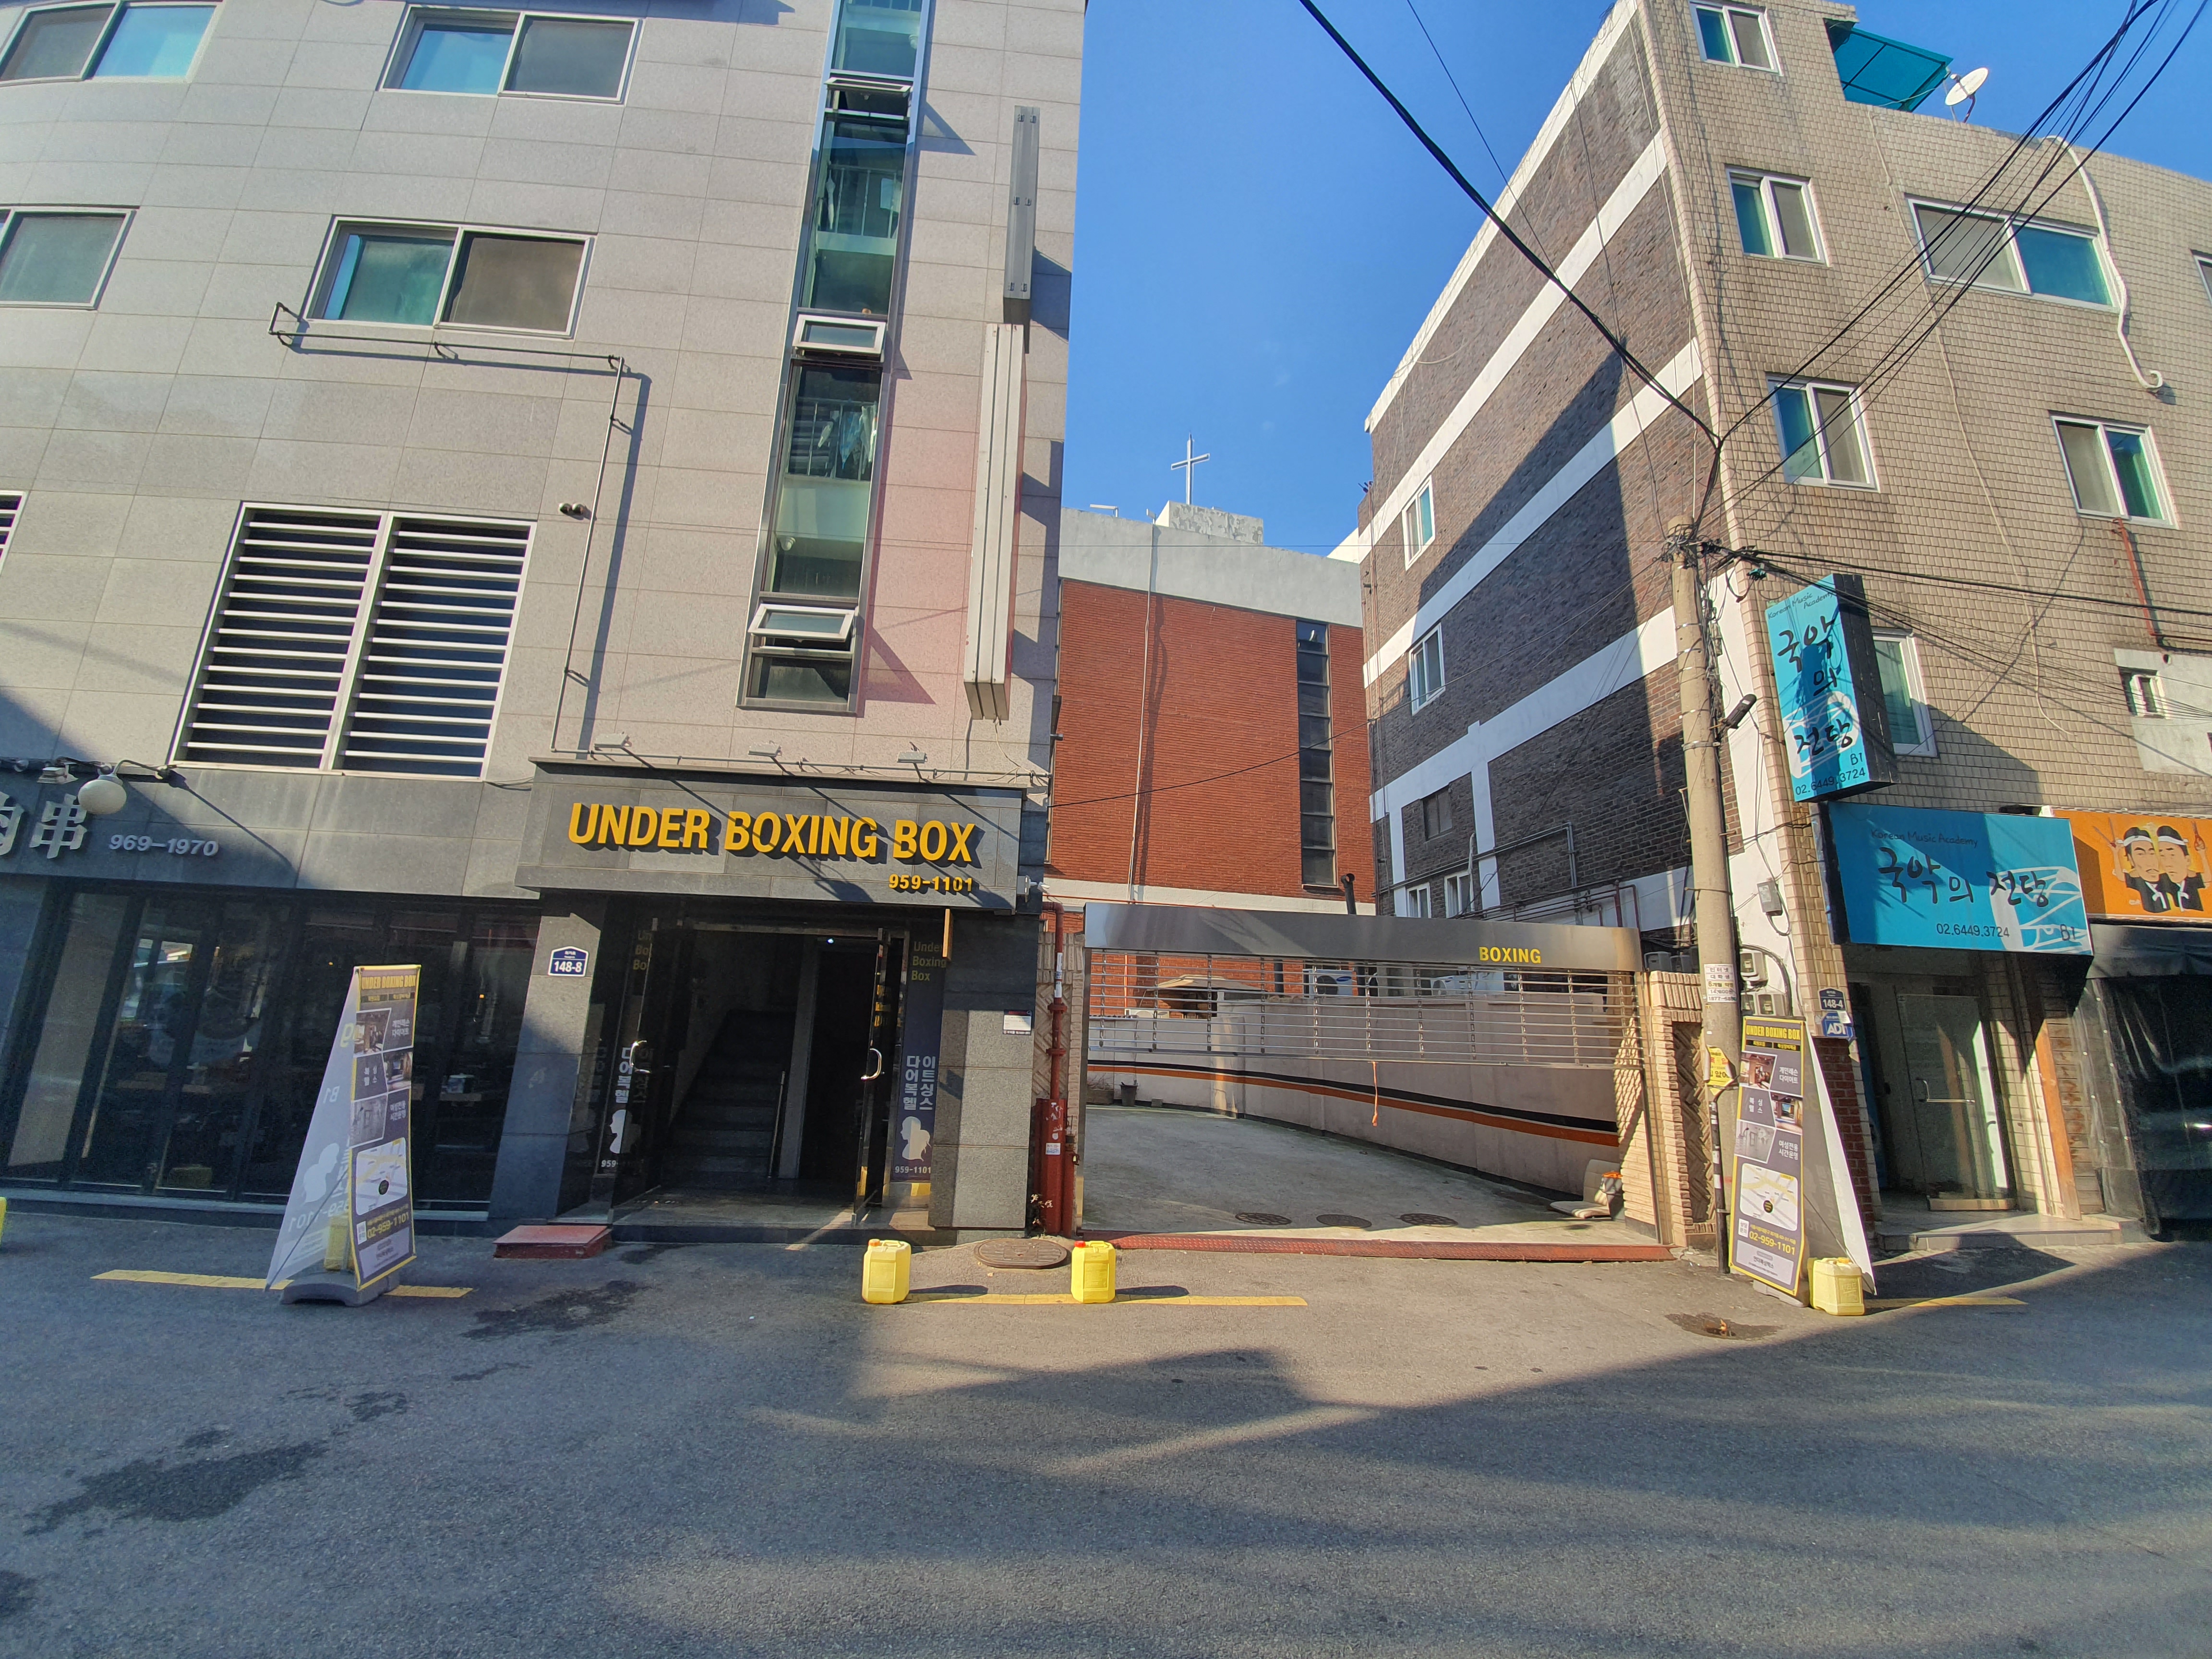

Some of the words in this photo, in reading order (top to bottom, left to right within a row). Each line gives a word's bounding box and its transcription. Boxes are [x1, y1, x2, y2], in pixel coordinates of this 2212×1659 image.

[1768, 604, 1791, 619] Korean
[1792, 593, 1813, 607] Music
[1803, 591, 1833, 609] Academy
[1777, 615, 1835, 673] 국악
[1813, 667, 1838, 696] 의
[1794, 719, 1853, 756] 전당
[1850, 753, 1864, 765] B1
[1795, 767, 1866, 795] 02.6449.3724
[568, 804, 709, 848] UNDER
[724, 812, 877, 857] BOXING
[893, 820, 974, 861] BOX
[1871, 829, 1904, 840] Korean
[1908, 830, 1936, 843] Music
[1939, 833, 1978, 849] Academy
[108, 834, 219, 857] 969-1970
[889, 874, 972, 891] 959-1101
[1878, 847, 1941, 904] 국악
[1949, 876, 1974, 903] 의
[1986, 871, 2049, 907] 전당
[1936, 923, 2010, 938] 02.6449.3724
[2060, 924, 2076, 941] B1
[913, 956, 947, 968] Boxing
[1479, 946, 1541, 964] BOXING
[554, 960, 583, 973] 148-8
[911, 970, 930, 981] Box
[1823, 999, 1844, 1009] 148-4
[1746, 1025, 1765, 1036] UNDER
[1765, 1026, 1787, 1039] BOXING
[1788, 1028, 1801, 1040] BOX
[1827, 1022, 1846, 1035] ADT
[895, 1166, 931, 1174] 959-1101
[1749, 1231, 1795, 1256] 02-959-1101
